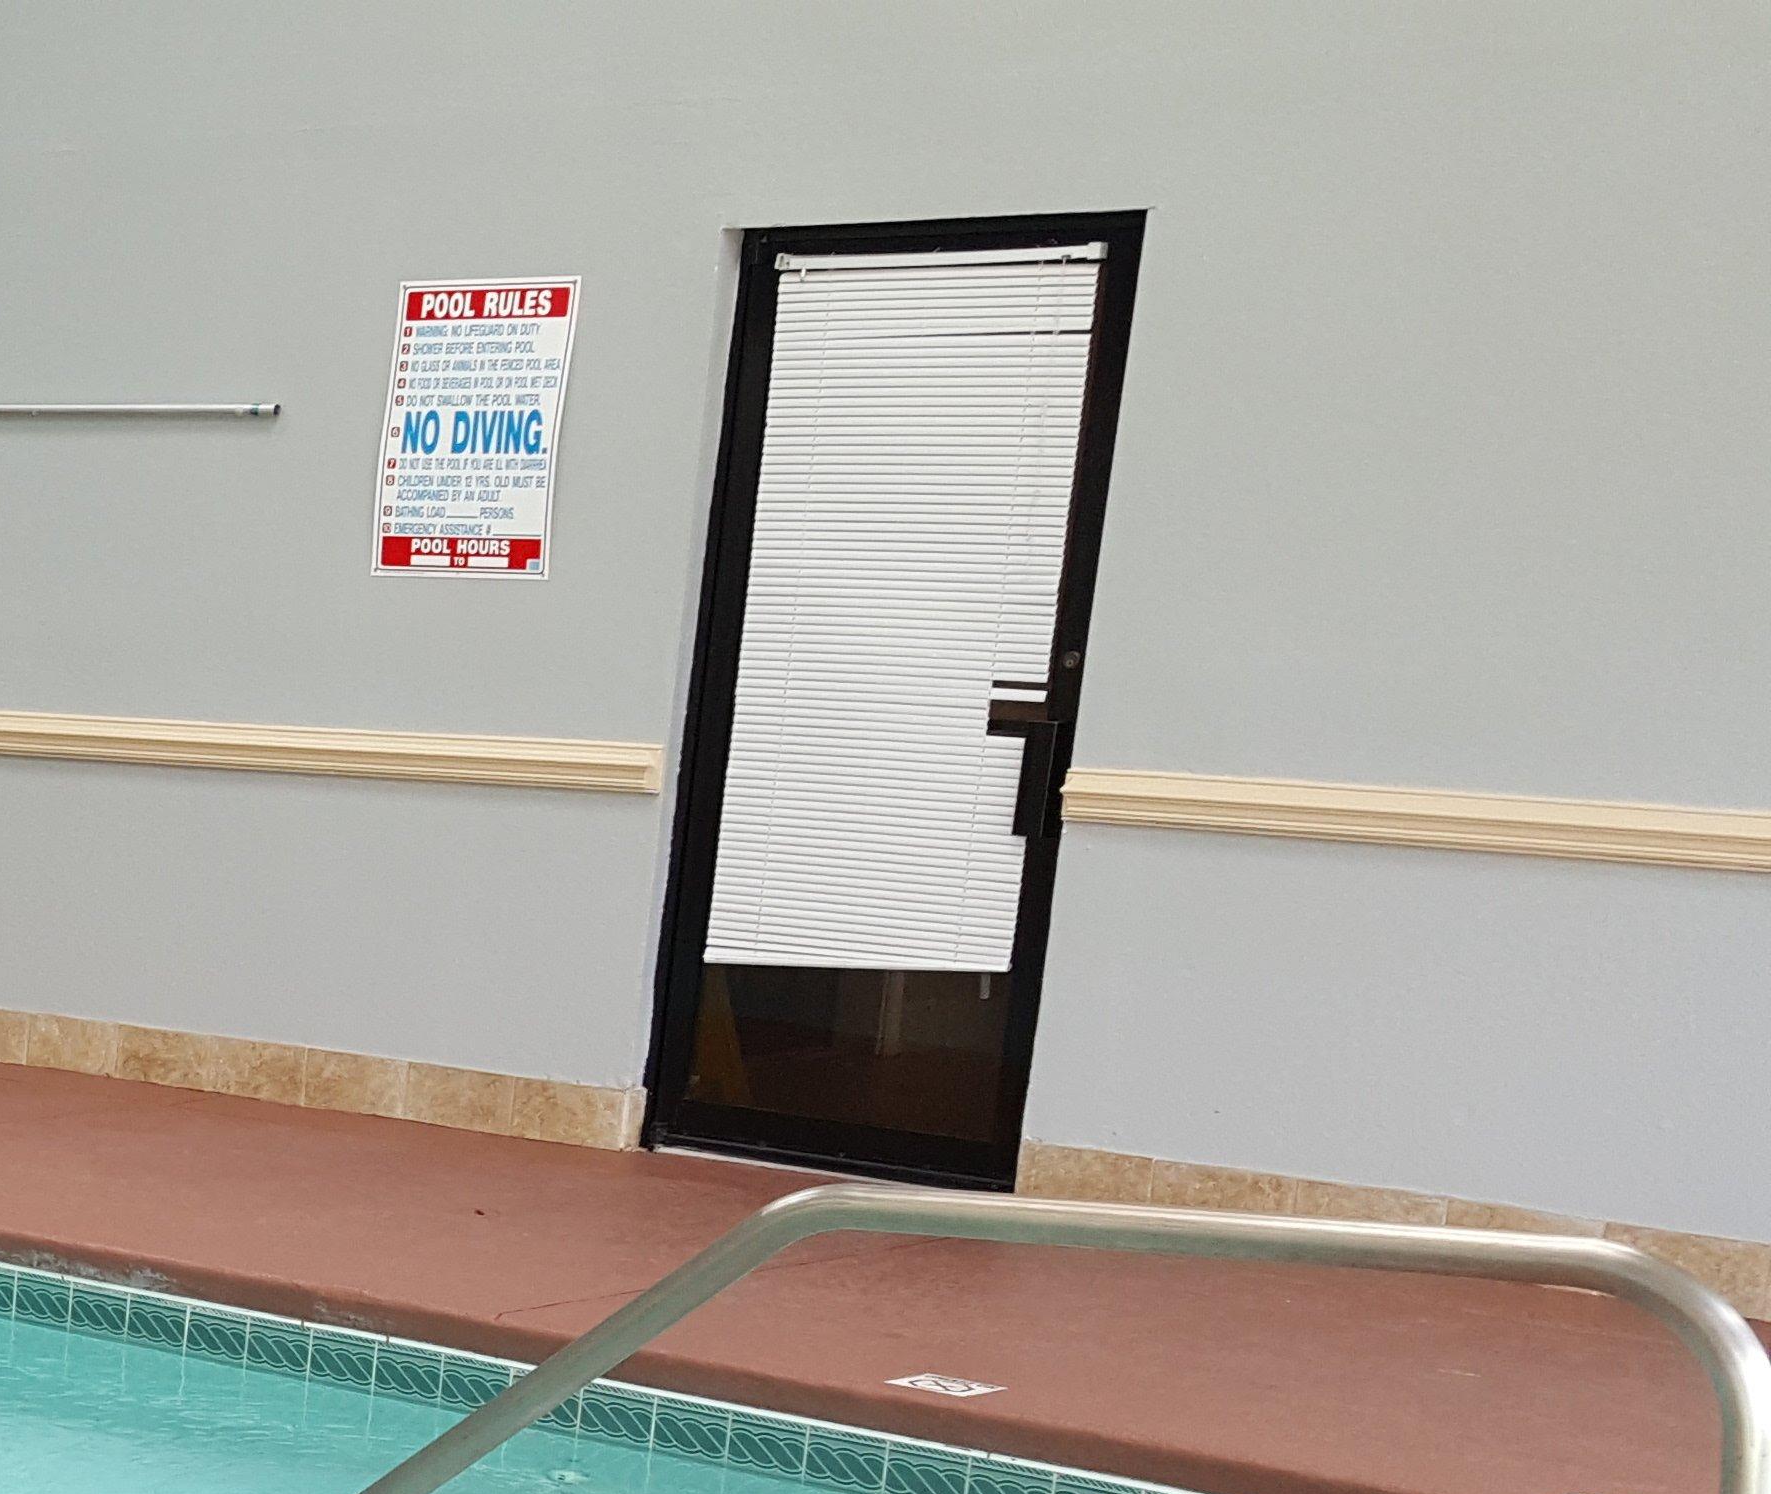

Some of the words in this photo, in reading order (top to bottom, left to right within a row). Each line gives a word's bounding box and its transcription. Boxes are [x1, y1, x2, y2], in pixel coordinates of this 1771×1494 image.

[421, 292, 475, 318] POOL
[483, 290, 552, 316] RULES
[401, 410, 440, 455] NO
[451, 409, 547, 455] DIVING.
[411, 538, 451, 554] POOL
[456, 540, 510, 555] HOURS
[454, 556, 466, 566] TO
